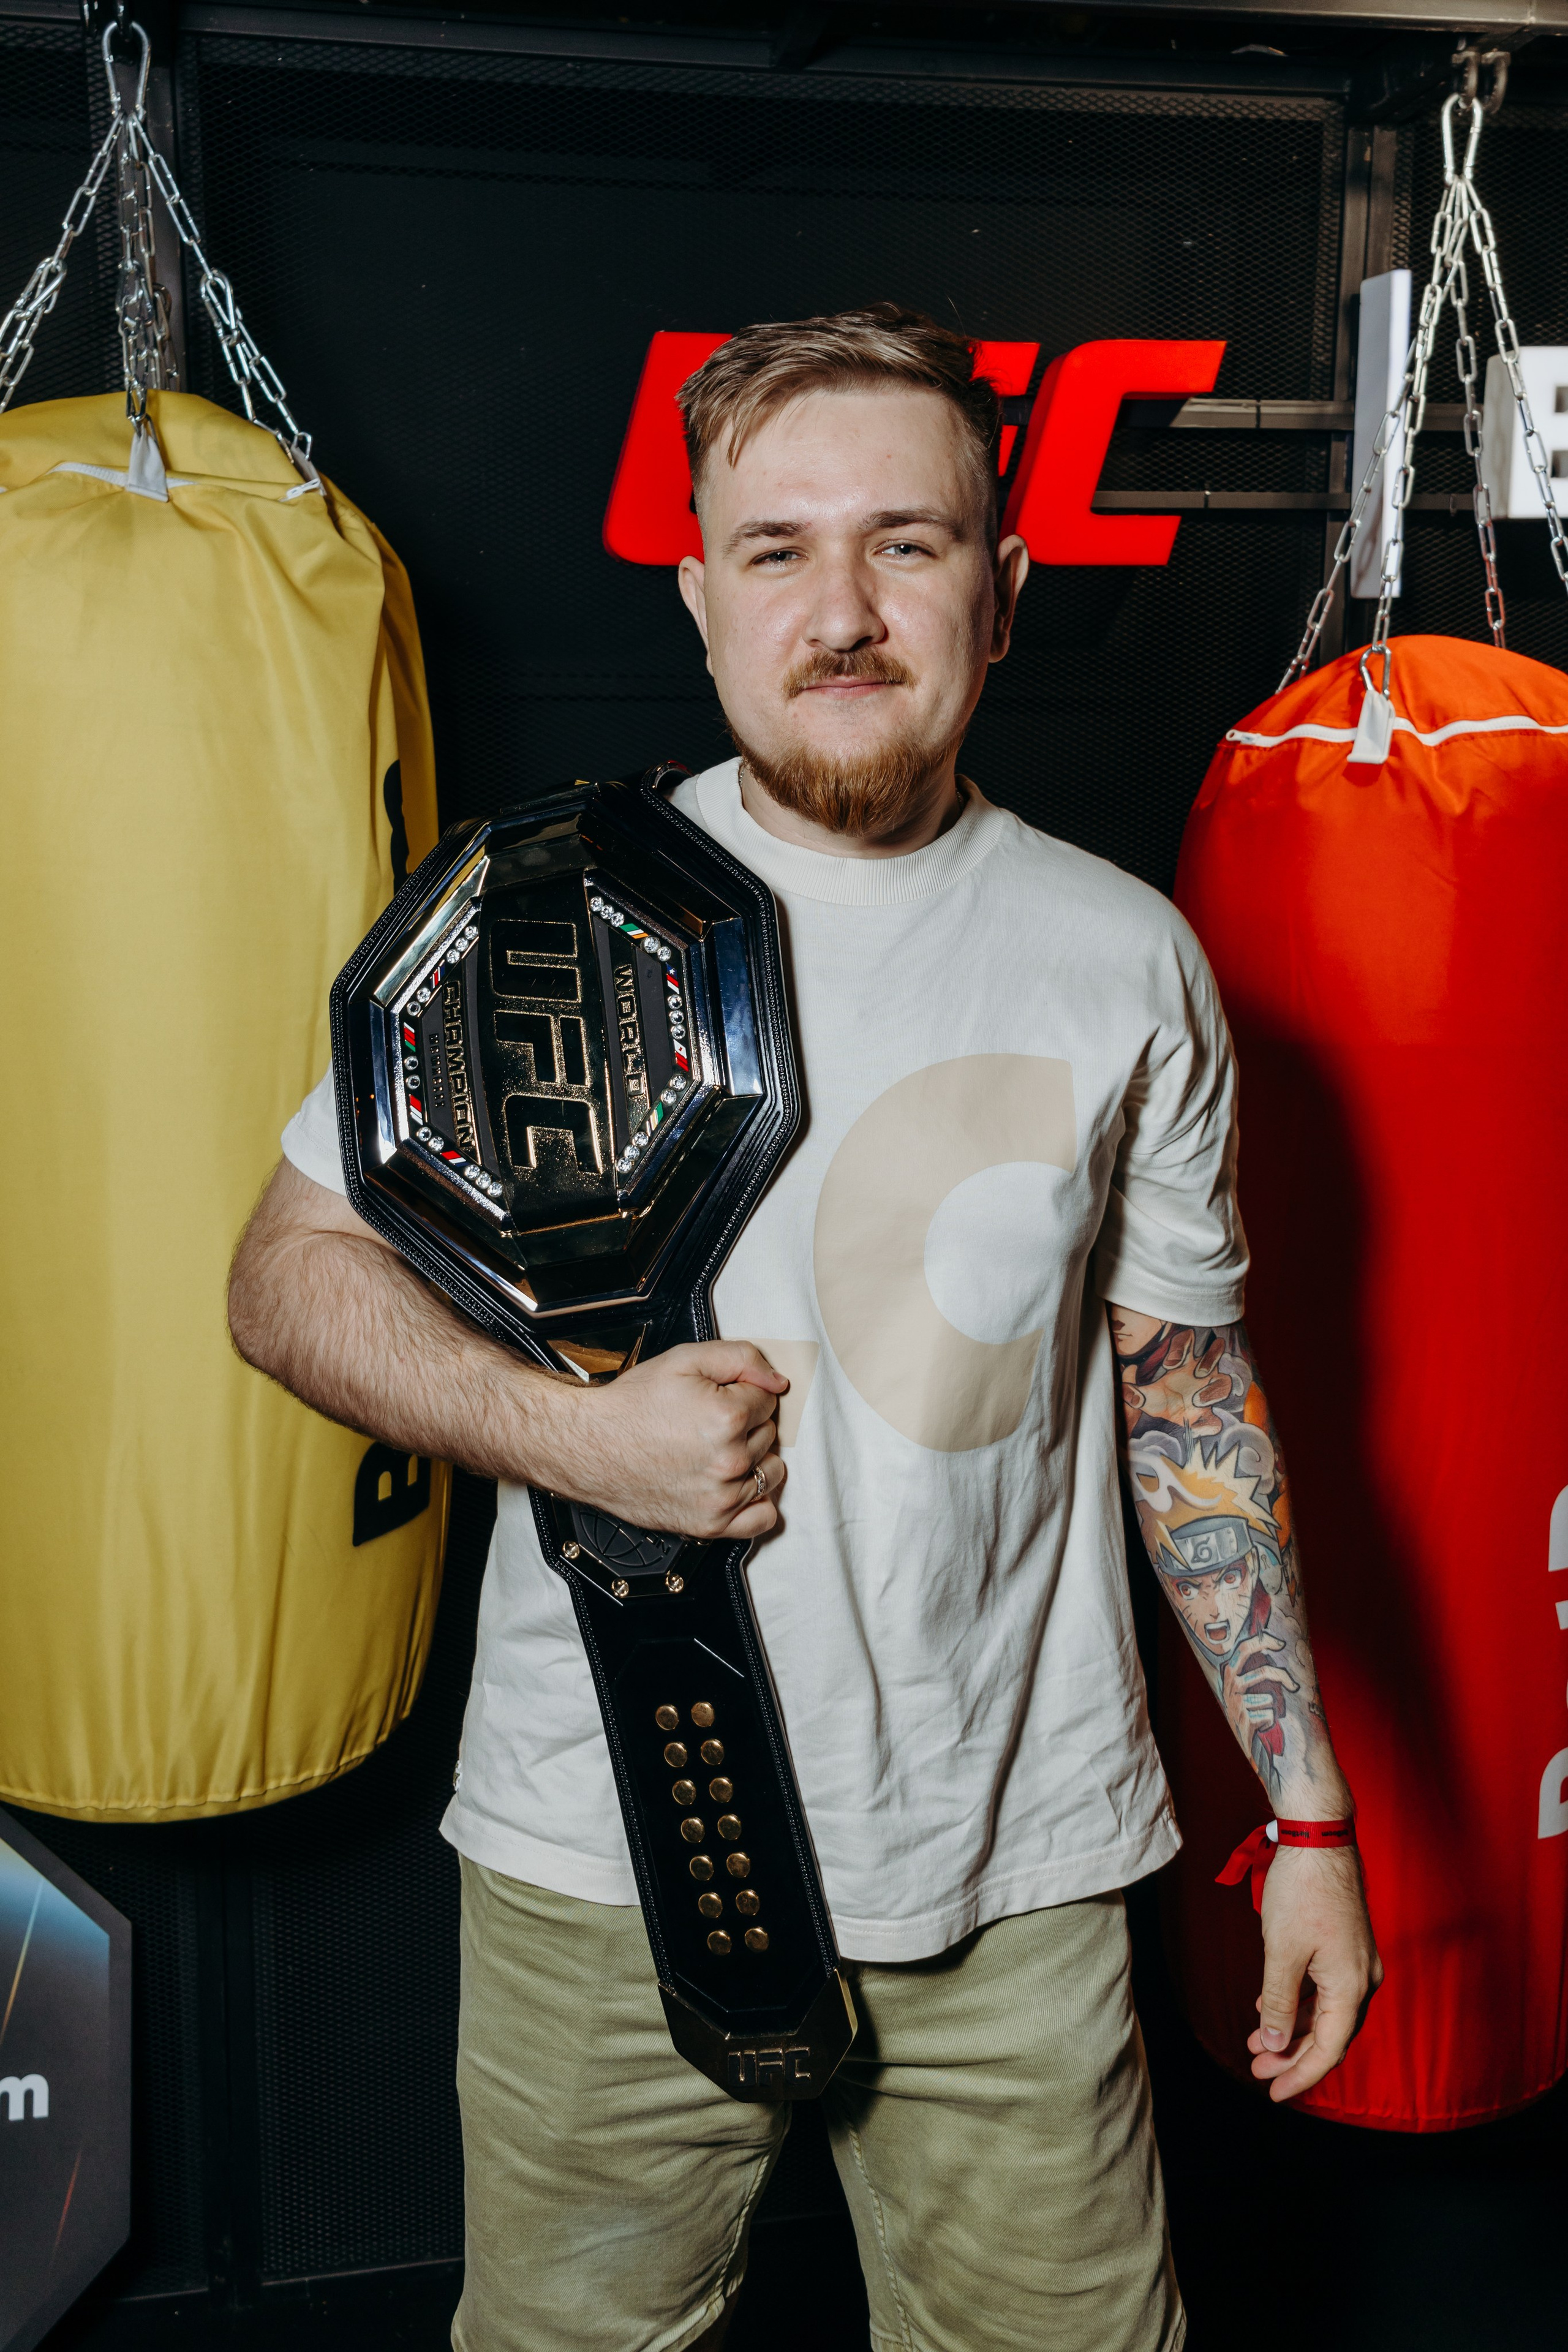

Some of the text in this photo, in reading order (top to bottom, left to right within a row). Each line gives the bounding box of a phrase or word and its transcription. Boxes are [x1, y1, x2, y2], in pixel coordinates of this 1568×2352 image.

[443, 980, 476, 1151] CHAMPION
[492, 919, 603, 1175] UFC
[614, 964, 644, 1096] WORLD
[727, 2047, 812, 2088] UFC
